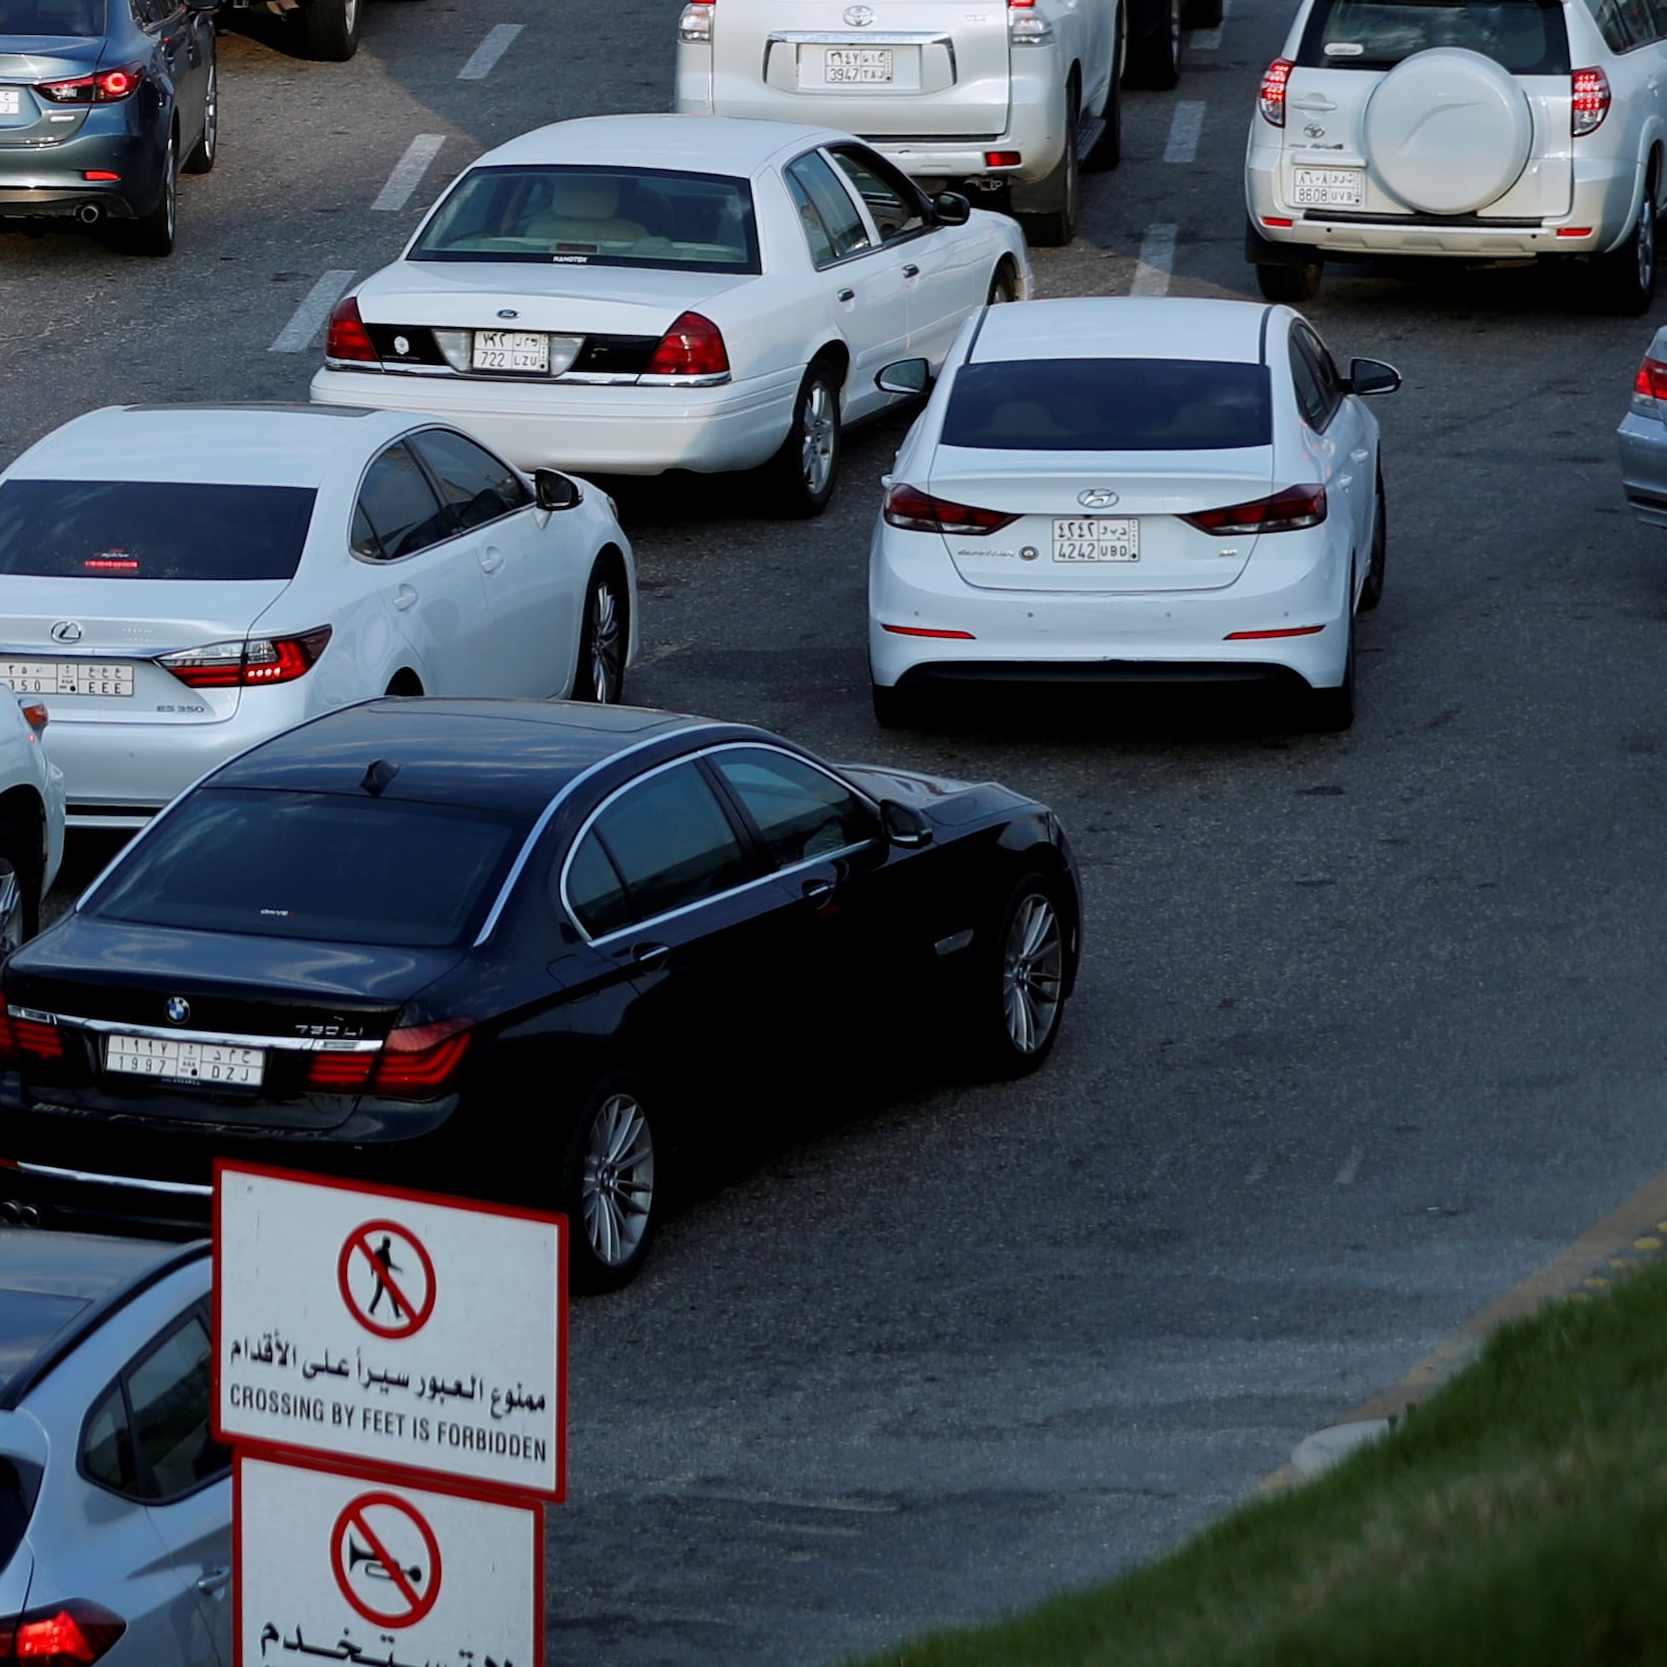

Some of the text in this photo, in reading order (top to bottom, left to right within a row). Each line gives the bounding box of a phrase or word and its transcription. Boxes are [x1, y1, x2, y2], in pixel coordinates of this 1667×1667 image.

[829, 67, 859, 82] 3947
[1297, 186, 1327, 202] 8608
[480, 352, 537, 368] 722 LZU
[1057, 522, 1096, 539] ٤٢٤٢
[1057, 543, 1128, 560] 4242 UBD
[9, 679, 124, 694] 350 EEE
[156, 705, 205, 714] ES 350
[294, 1024, 341, 1036] 730
[120, 1037, 167, 1056] ١٩٩٧
[118, 1057, 251, 1082] 1997 DZJ
[229, 1328, 297, 1367] الأقدام
[301, 1347, 351, 1381] على
[416, 1372, 484, 1405] العبور
[490, 1381, 546, 1420] ممنوع
[229, 1383, 547, 1463] CROSSING BY FEET IS FORBIDDEN
